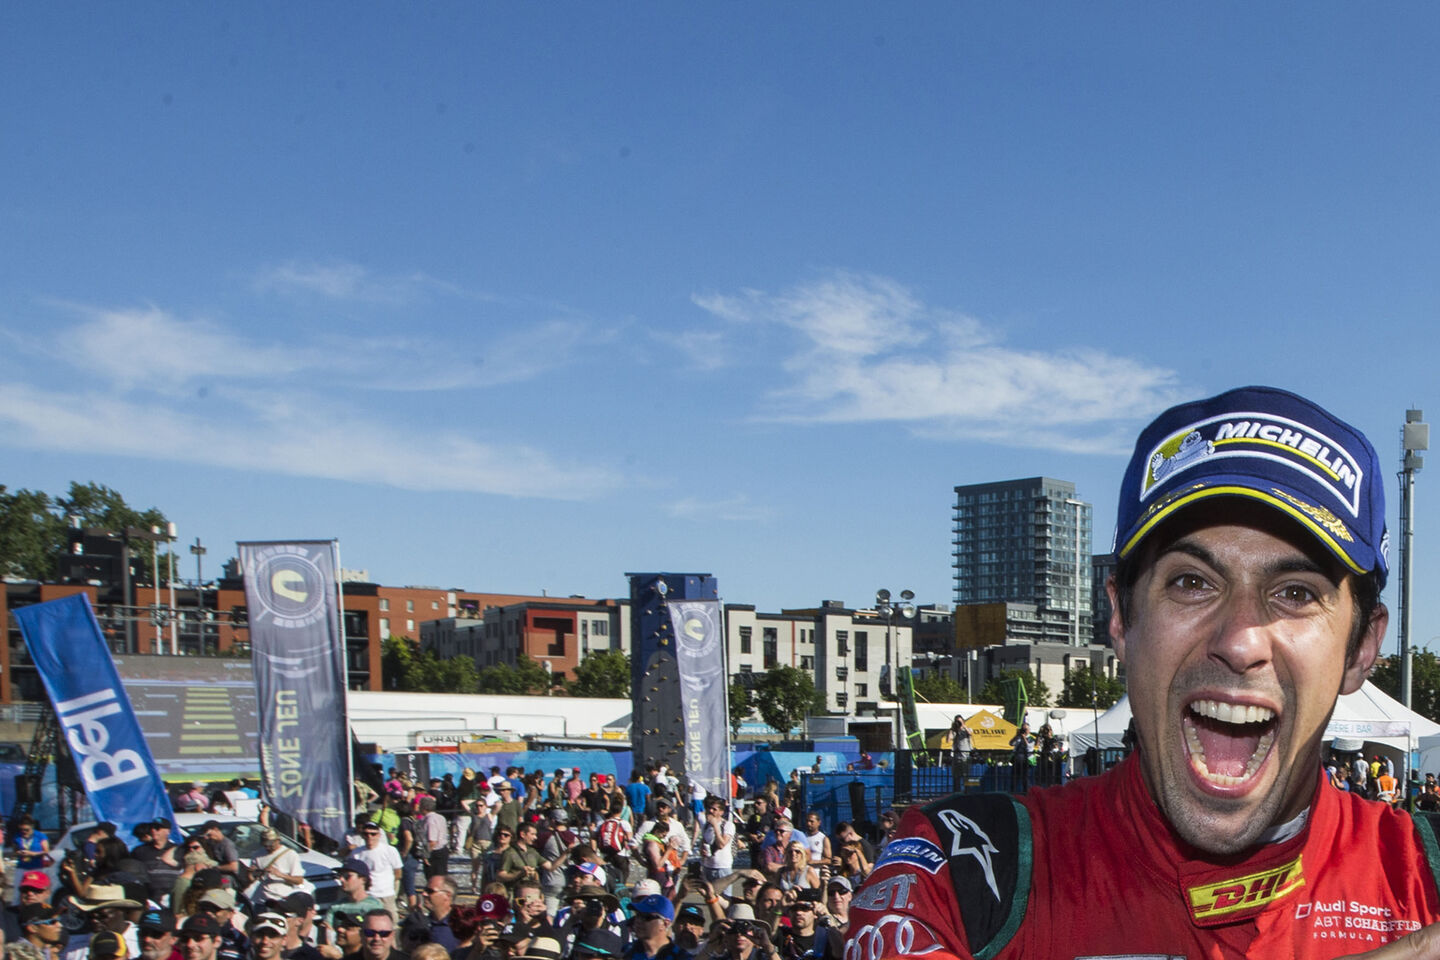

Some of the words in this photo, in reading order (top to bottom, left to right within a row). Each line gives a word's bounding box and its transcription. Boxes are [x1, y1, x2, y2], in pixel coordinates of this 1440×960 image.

[1215, 421, 1356, 489] MICHELIN
[56, 688, 149, 792] Bell
[1212, 869, 1294, 910] DHL
[1314, 900, 1346, 913] Audi
[1349, 901, 1392, 917] Sport
[1314, 916, 1341, 928] ABT
[1313, 932, 1374, 942] FORMULA
